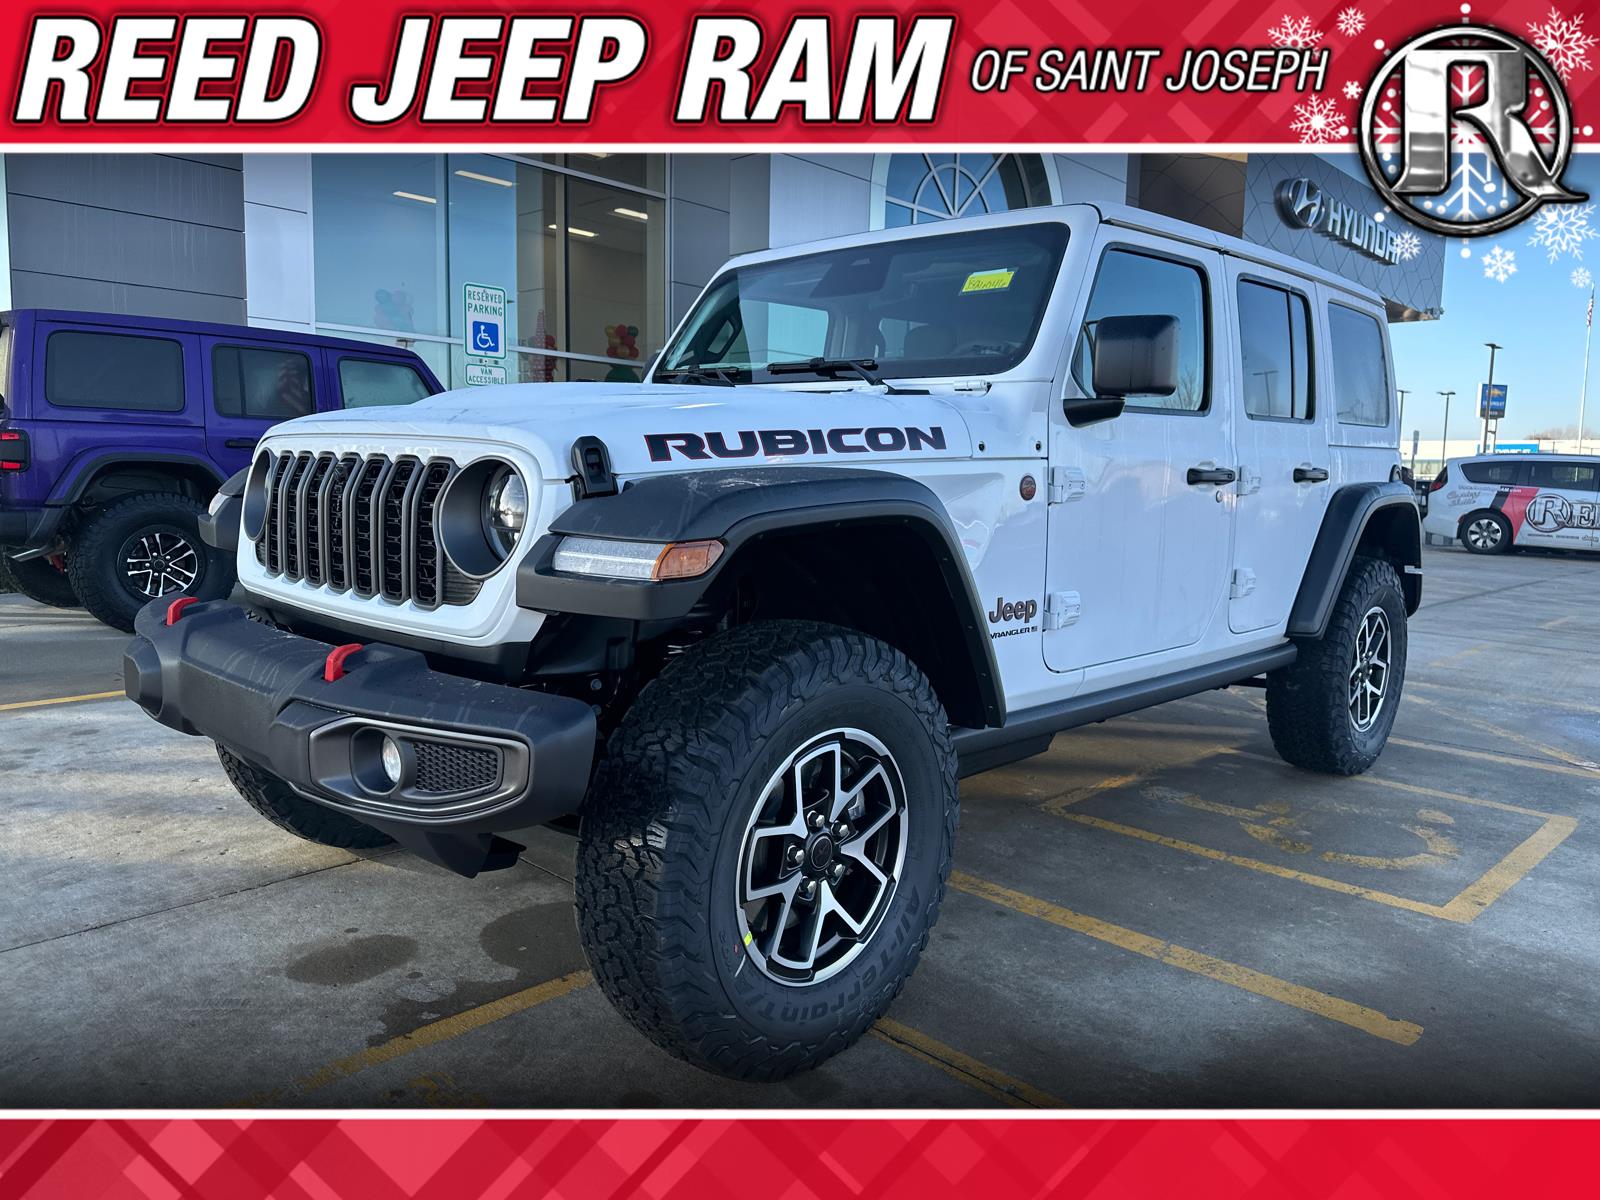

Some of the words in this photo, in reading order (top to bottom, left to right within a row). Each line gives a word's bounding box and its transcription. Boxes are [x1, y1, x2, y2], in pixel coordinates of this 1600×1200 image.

[467, 289, 502, 304] RESERVED
[467, 302, 503, 317] PARKING
[480, 367, 493, 375] VAN
[468, 375, 505, 385] ACCESSIBLE
[643, 426, 947, 463] RUBICON
[1527, 495, 1600, 532] RE
[988, 597, 1038, 624] Jeep
[989, 627, 1030, 639] WRANGLER
